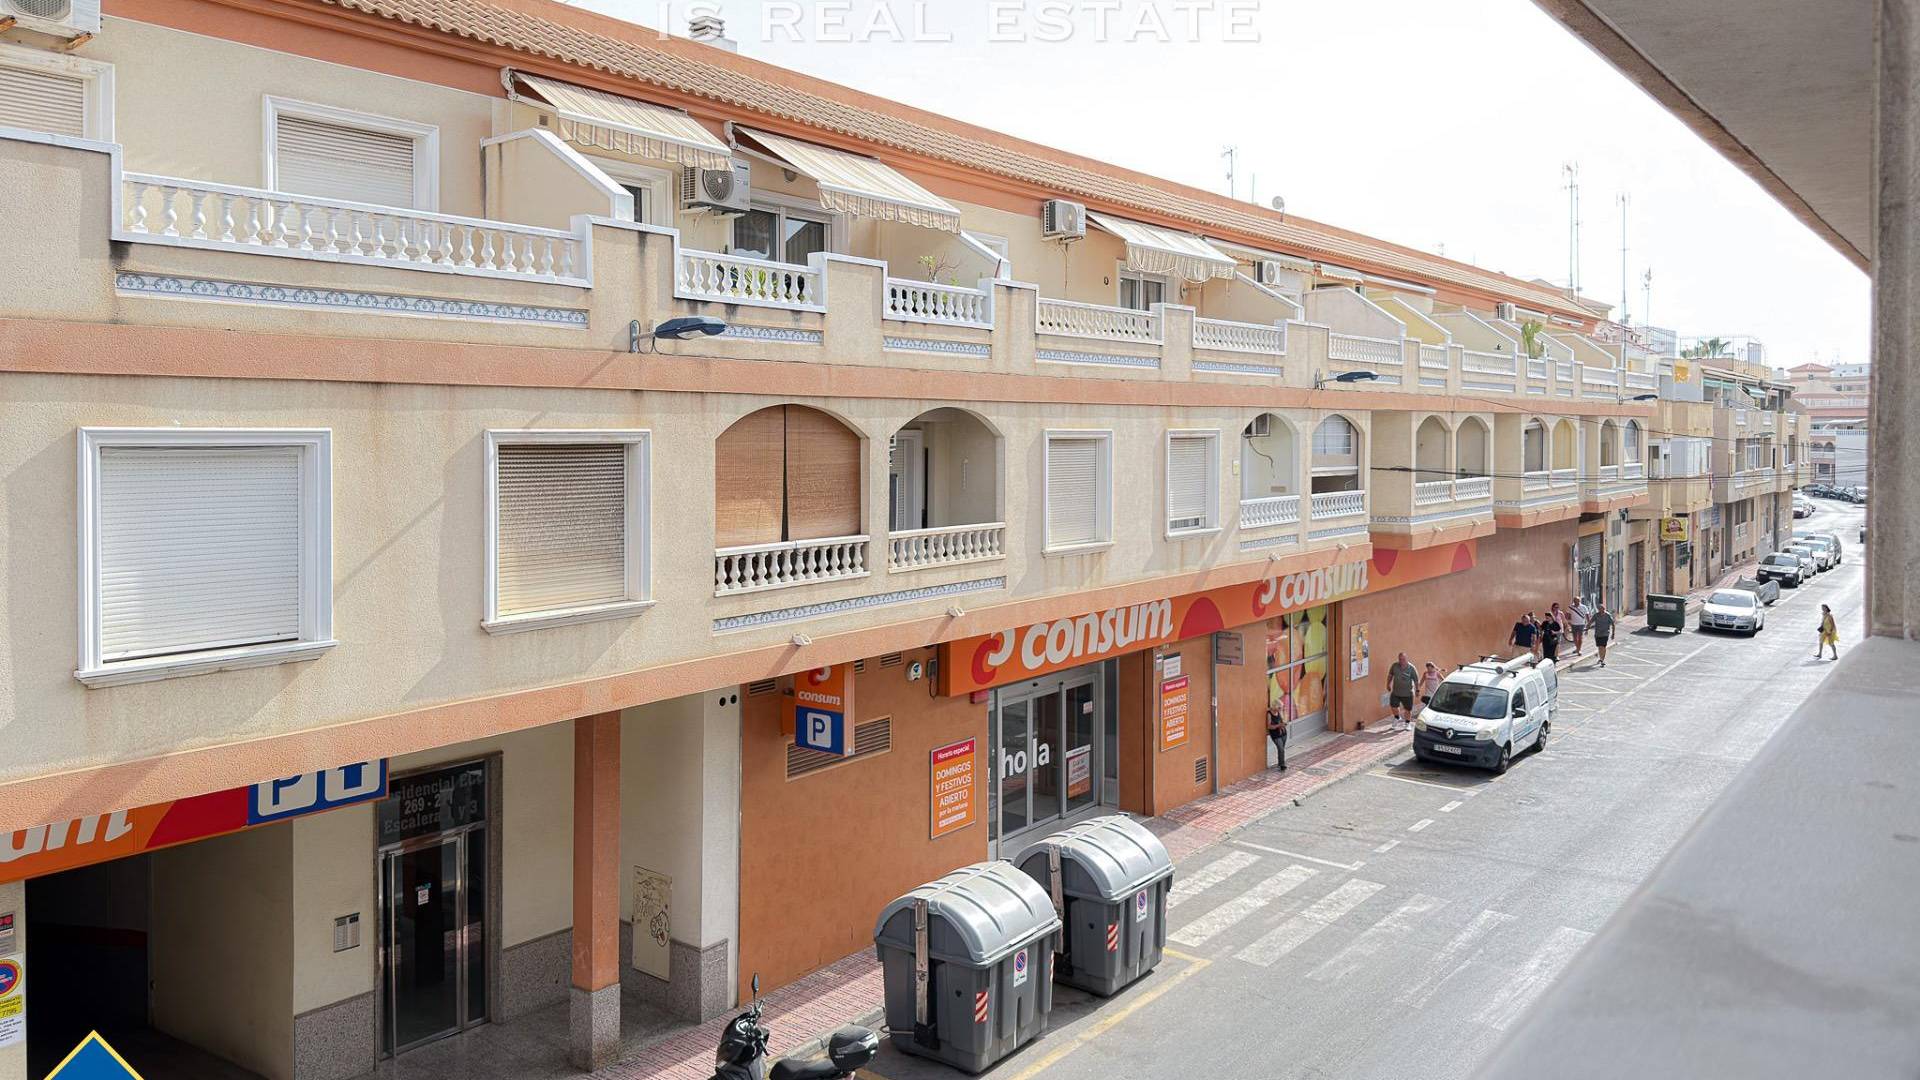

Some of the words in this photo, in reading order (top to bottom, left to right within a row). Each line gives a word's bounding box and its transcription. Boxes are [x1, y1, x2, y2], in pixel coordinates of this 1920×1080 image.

[1280, 560, 1369, 609] consum
[1021, 598, 1174, 670] consum
[798, 691, 840, 706] consum
[813, 717, 826, 741] P
[1000, 738, 1050, 779] hola
[936, 761, 972, 781] DOMINGOS
[941, 774, 972, 792] FESTIVOS
[940, 789, 968, 808] ABIERTO
